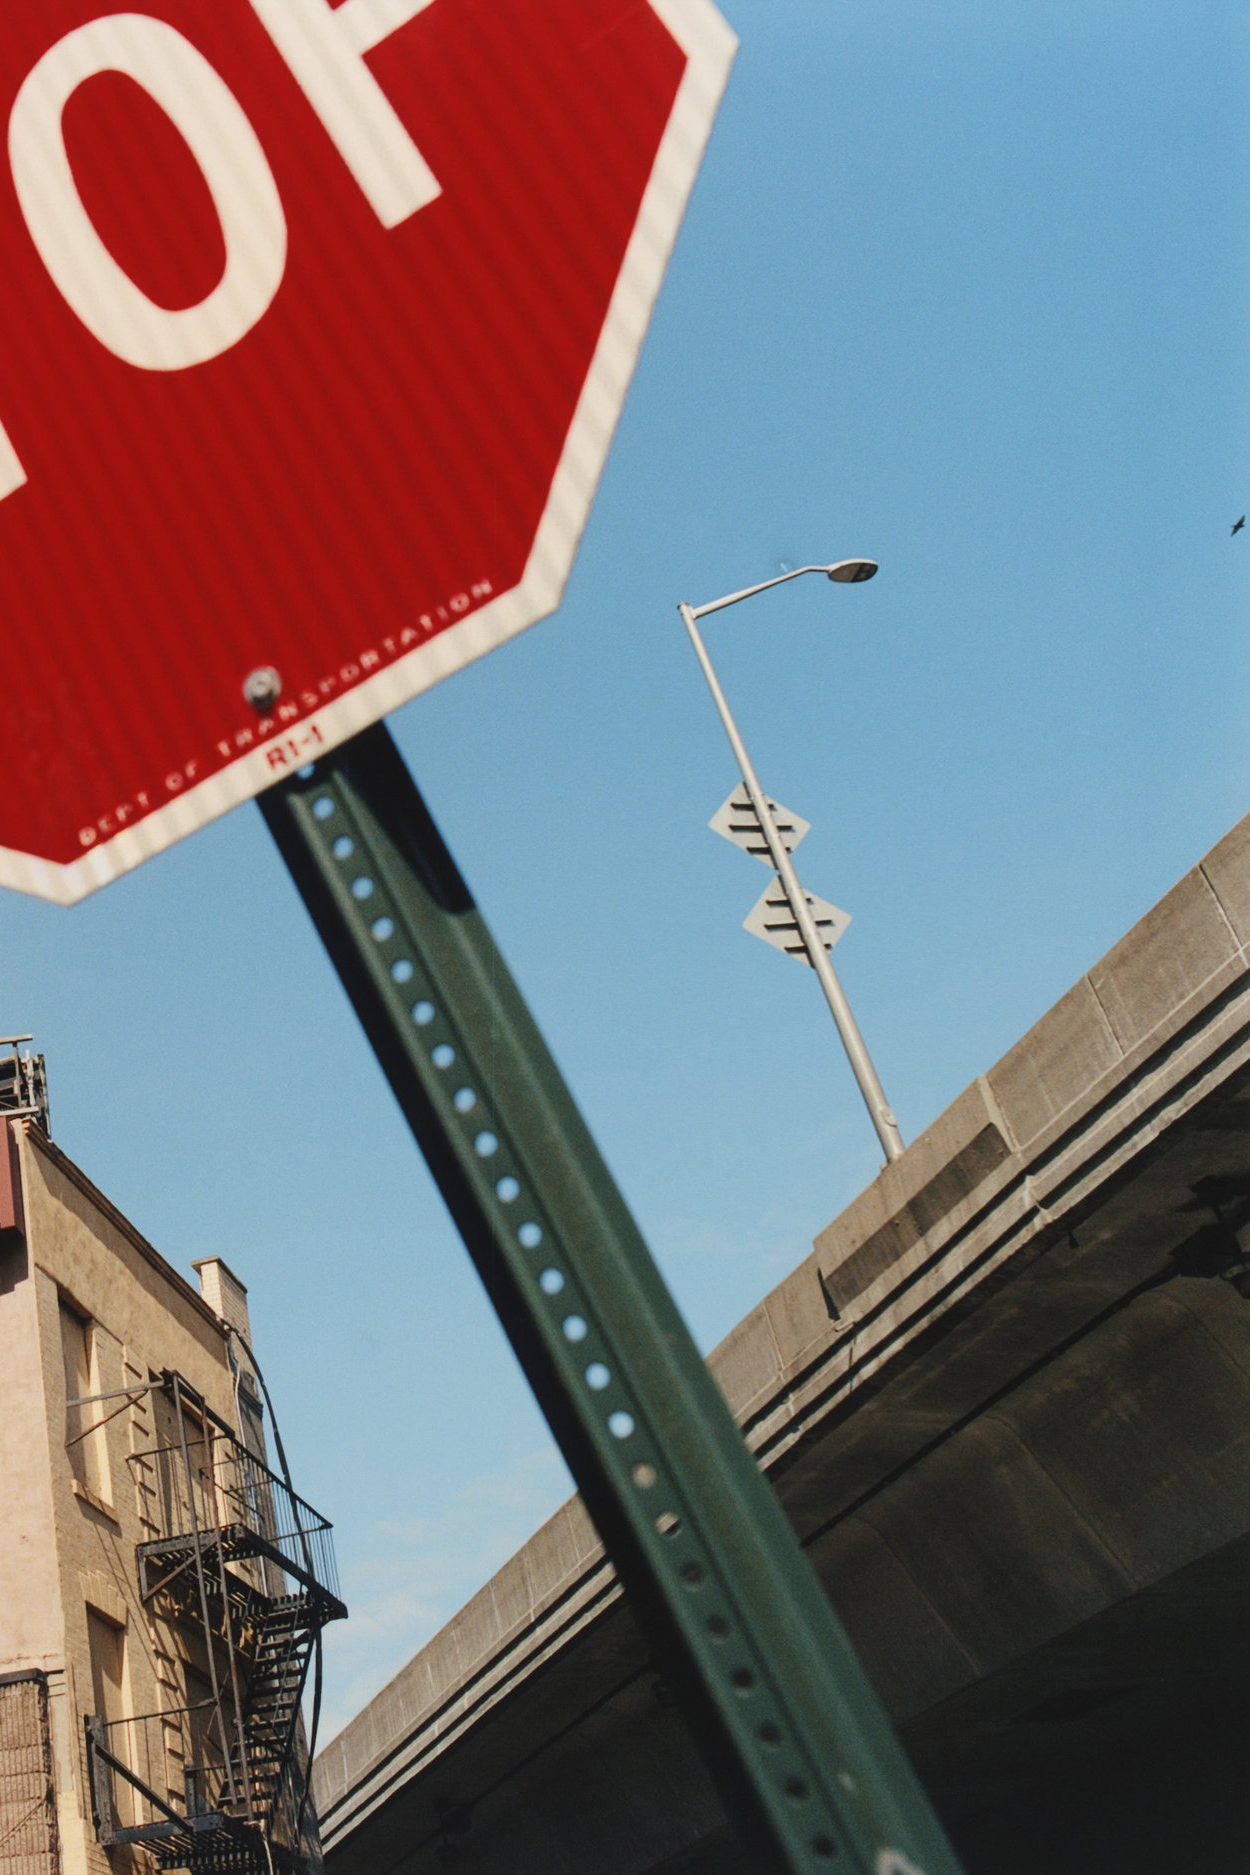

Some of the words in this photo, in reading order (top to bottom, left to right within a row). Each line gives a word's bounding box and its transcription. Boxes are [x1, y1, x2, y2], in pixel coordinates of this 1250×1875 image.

[78, 791, 149, 847] DEPT
[165, 759, 197, 791] OF
[216, 578, 493, 758] TRANSPORTATION
